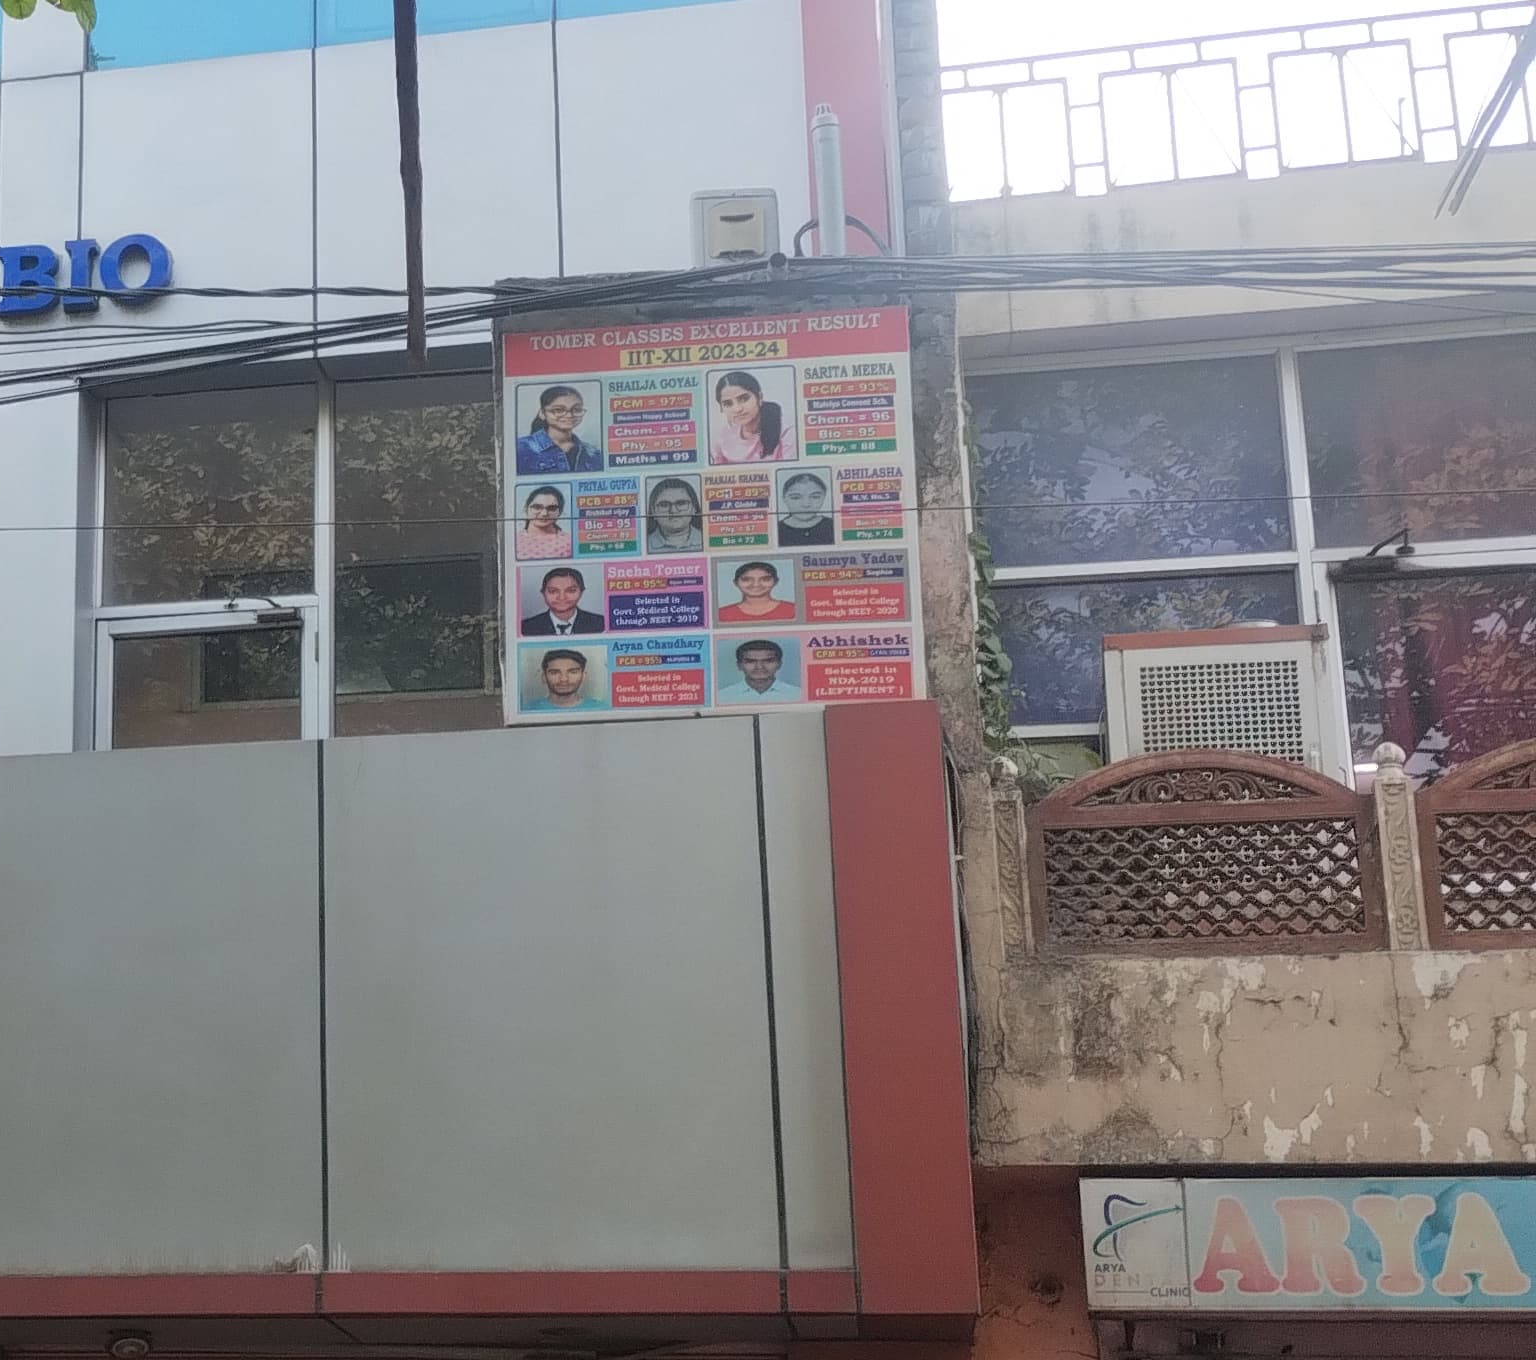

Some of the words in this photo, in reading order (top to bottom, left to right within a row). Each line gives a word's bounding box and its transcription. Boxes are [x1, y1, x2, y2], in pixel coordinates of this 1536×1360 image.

[530, 333, 596, 351] TOMER
[602, 328, 684, 346] CLASSES
[690, 319, 800, 340] EXCELLENT
[807, 313, 880, 332] RESULT
[628, 347, 691, 366] IIT-XII
[698, 341, 780, 361] 2023-24
[803, 365, 849, 380] SARITA
[852, 362, 895, 377] MEENA
[608, 380, 656, 392] SHAILJA
[660, 376, 699, 388] GOYAL
[810, 385, 842, 395] PCM
[613, 398, 643, 409] PCM
[807, 414, 854, 425] Chem.
[871, 411, 890, 422] 96
[614, 425, 657, 436] Chem.
[818, 429, 842, 439] Bio
[858, 427, 877, 437] 95
[615, 453, 657, 465] Maths
[672, 452, 690, 462] 99
[836, 467, 903, 480] ABHILASHA
[802, 554, 858, 568] Saumya
[861, 552, 904, 566] Yadav
[607, 565, 651, 578] Sneha
[654, 564, 700, 576] Tomer
[612, 641, 643, 653] Aryan
[807, 634, 910, 647] Abhishek
[824, 666, 880, 675] Selected
[1193, 1191, 1532, 1297] ARYA
[1094, 1263, 1126, 1273] ARYA
